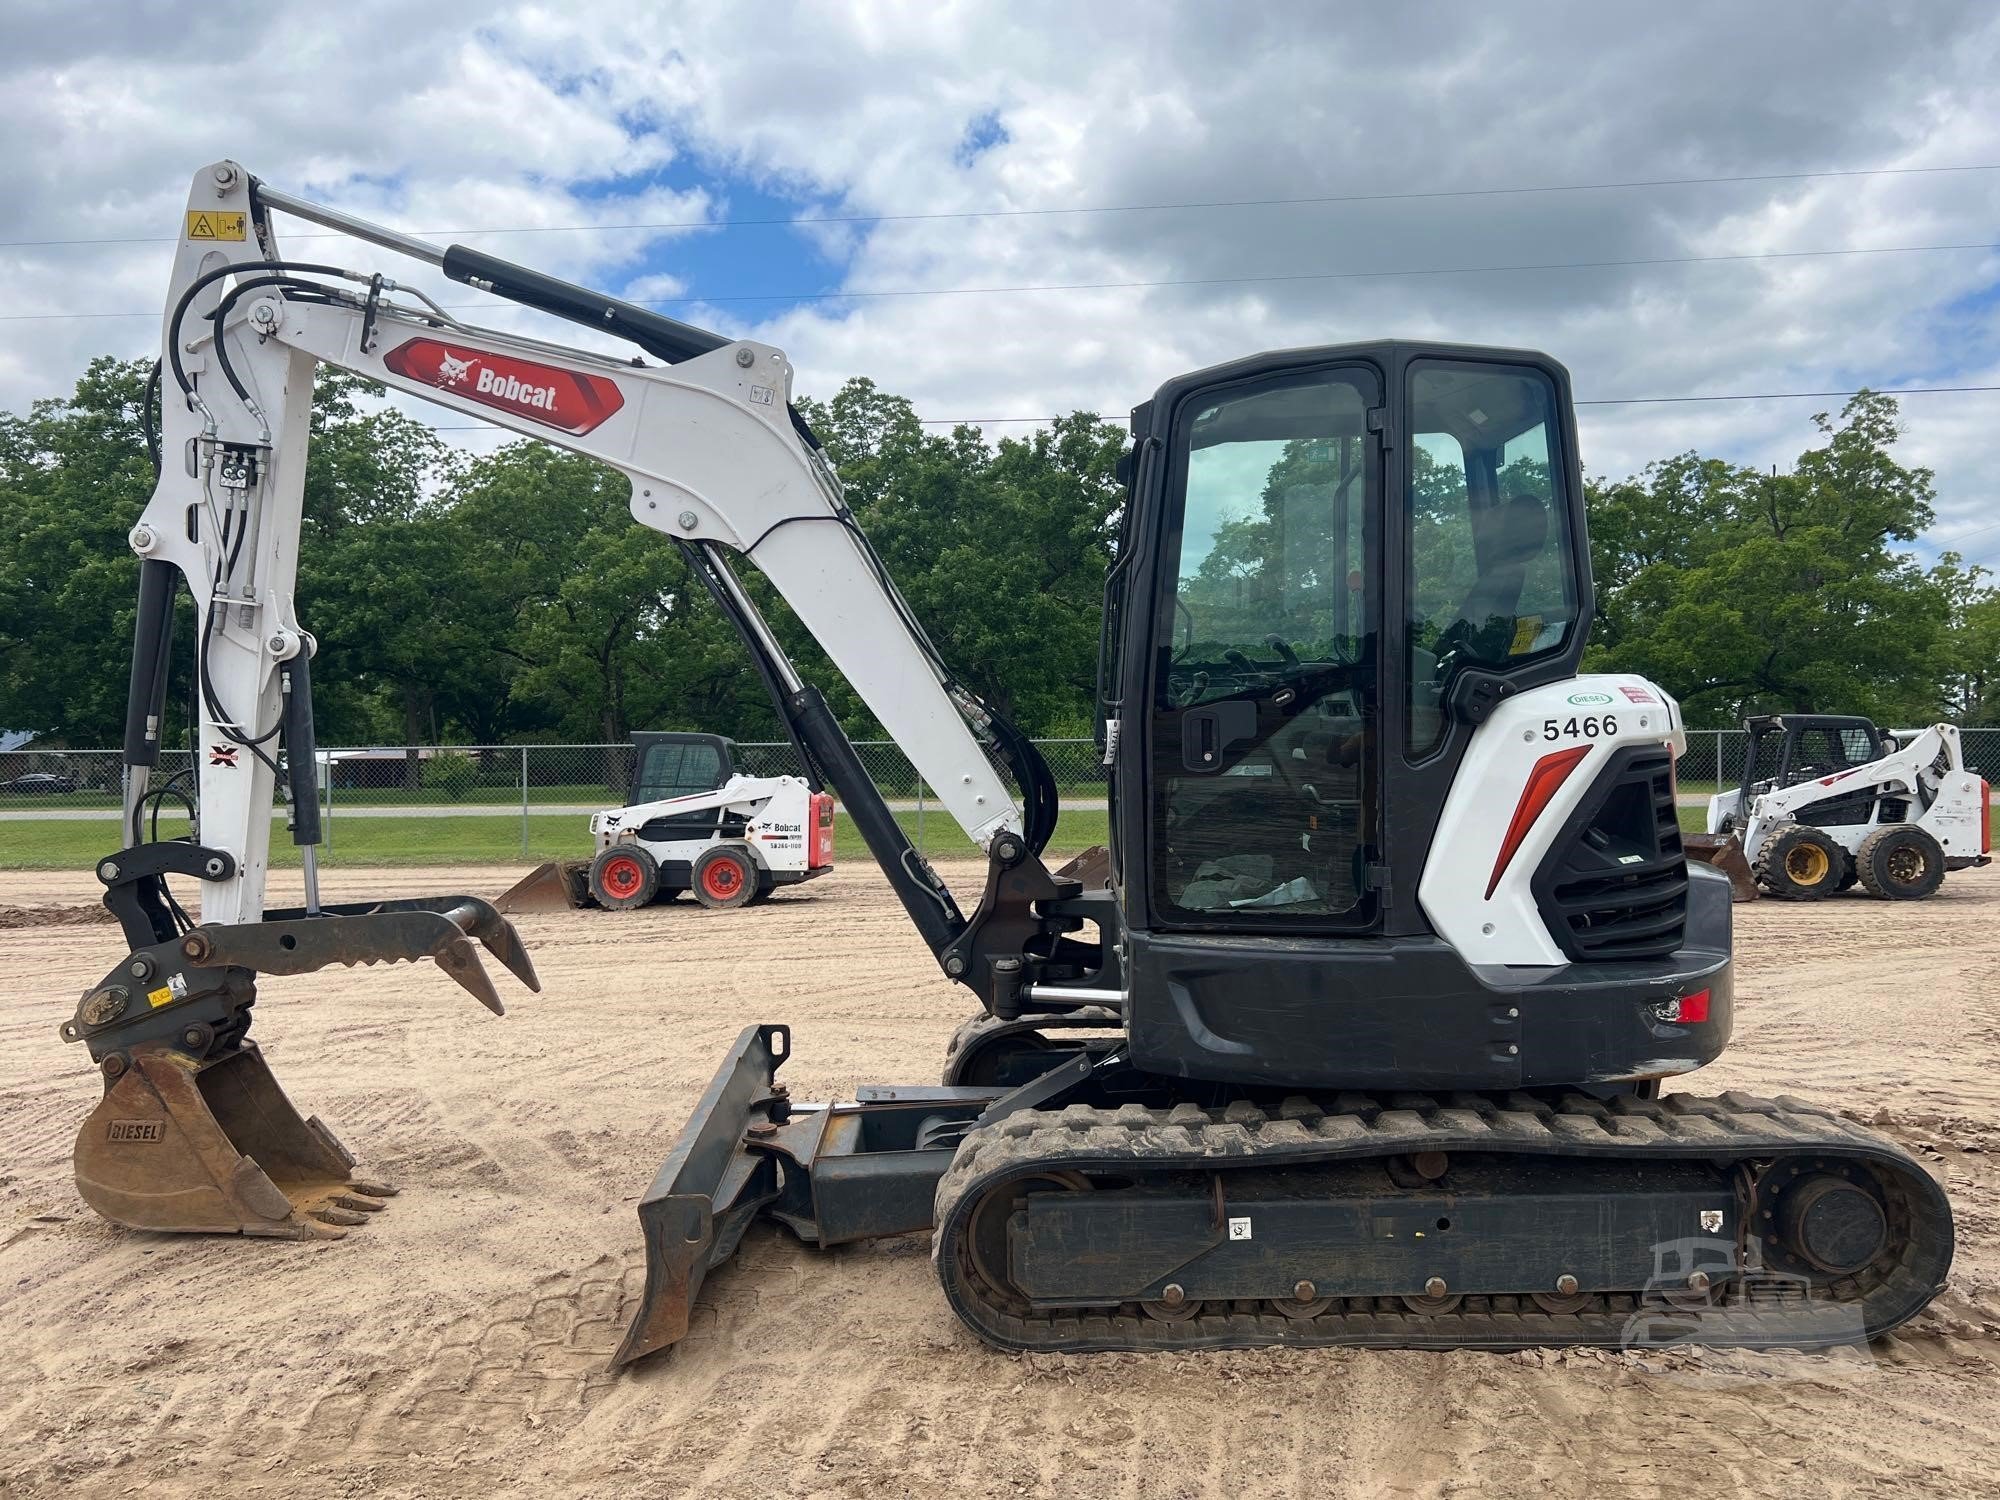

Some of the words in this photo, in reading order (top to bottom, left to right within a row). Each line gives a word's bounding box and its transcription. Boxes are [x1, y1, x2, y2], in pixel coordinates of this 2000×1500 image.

[477, 367, 557, 411] Bobcat
[1574, 694, 1606, 703] DIESEL
[1543, 714, 1618, 741] 5466
[774, 823, 801, 832] Bobcat
[111, 1124, 157, 1140] DIESEL
